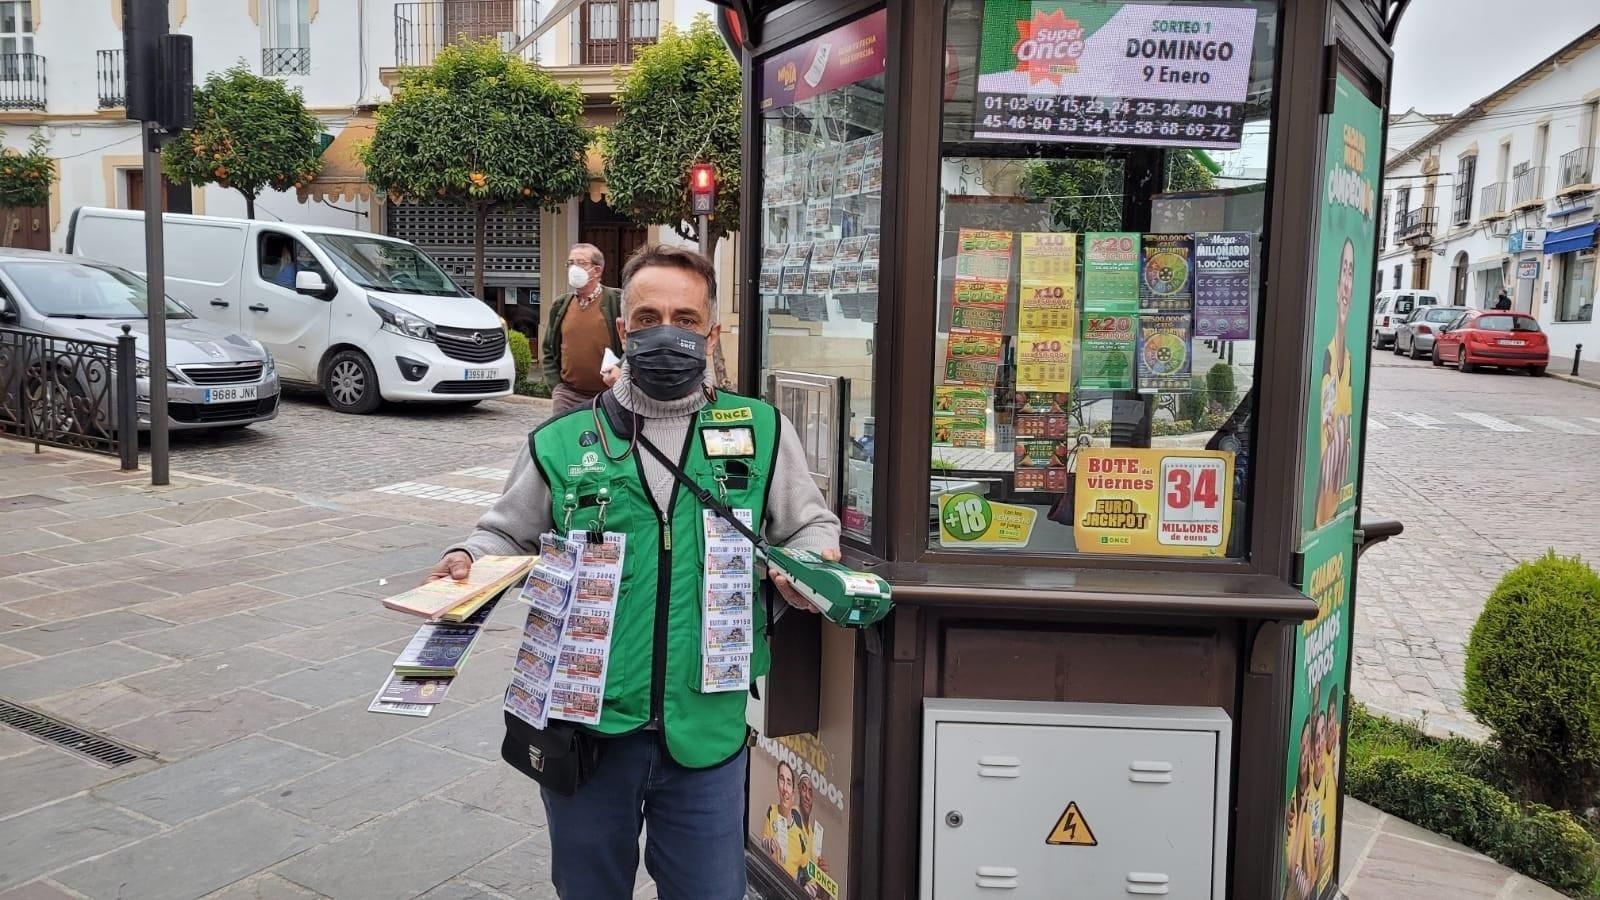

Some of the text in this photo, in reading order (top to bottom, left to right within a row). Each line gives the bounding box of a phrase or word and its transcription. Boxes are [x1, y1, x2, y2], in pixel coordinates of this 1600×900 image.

[1152, 20, 1212, 34] SORTEO 1
[1125, 38, 1234, 61] DOMINGO
[1142, 66, 1210, 84] 9 Enero
[1212, 235, 1236, 245] Mega
[1197, 245, 1250, 257] MILLONARIO
[1197, 260, 1250, 268] 1.000.000€
[1034, 287, 1064, 298] x10
[1088, 317, 1131, 331] x20
[1032, 340, 1061, 352] x10
[212, 387, 256, 400] 9688 JNK
[715, 410, 748, 420] ONCE
[1088, 458, 1139, 474] BOTE
[1087, 475, 1154, 490] viernes
[1167, 468, 1219, 509] 34
[1096, 499, 1134, 513] EURO
[945, 498, 986, 534] +18
[1082, 512, 1147, 529] JACKPOT
[1162, 523, 1218, 534] MILLONES
[1109, 536, 1129, 544] ONCE
[1310, 551, 1344, 596] CUANDO
[1304, 610, 1341, 670] JUGAMOS
[1308, 644, 1335, 694] TODOS
[816, 869, 837, 895] ONCE
